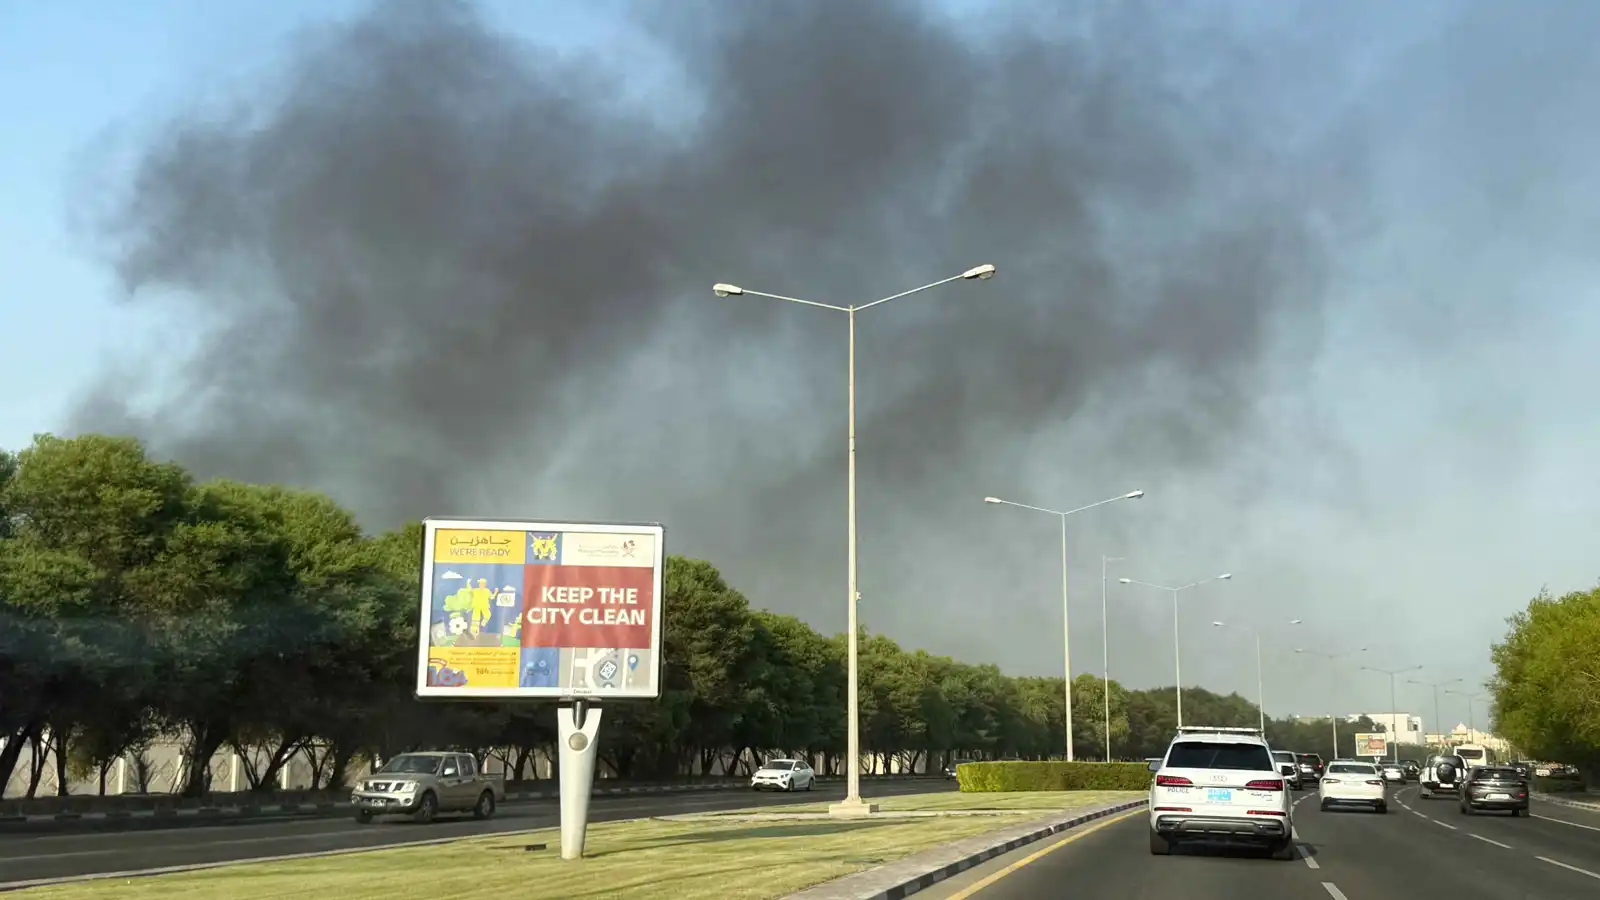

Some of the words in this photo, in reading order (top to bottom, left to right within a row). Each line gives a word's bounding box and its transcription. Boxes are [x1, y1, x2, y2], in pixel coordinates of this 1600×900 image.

[450, 535, 512, 547] جاهزين
[479, 548, 511, 557] READY
[541, 586, 594, 604] KEEP
[596, 587, 638, 605] THE
[526, 607, 577, 625] CITY
[579, 608, 646, 626] CLEAN
[1167, 787, 1190, 795] POLICE
